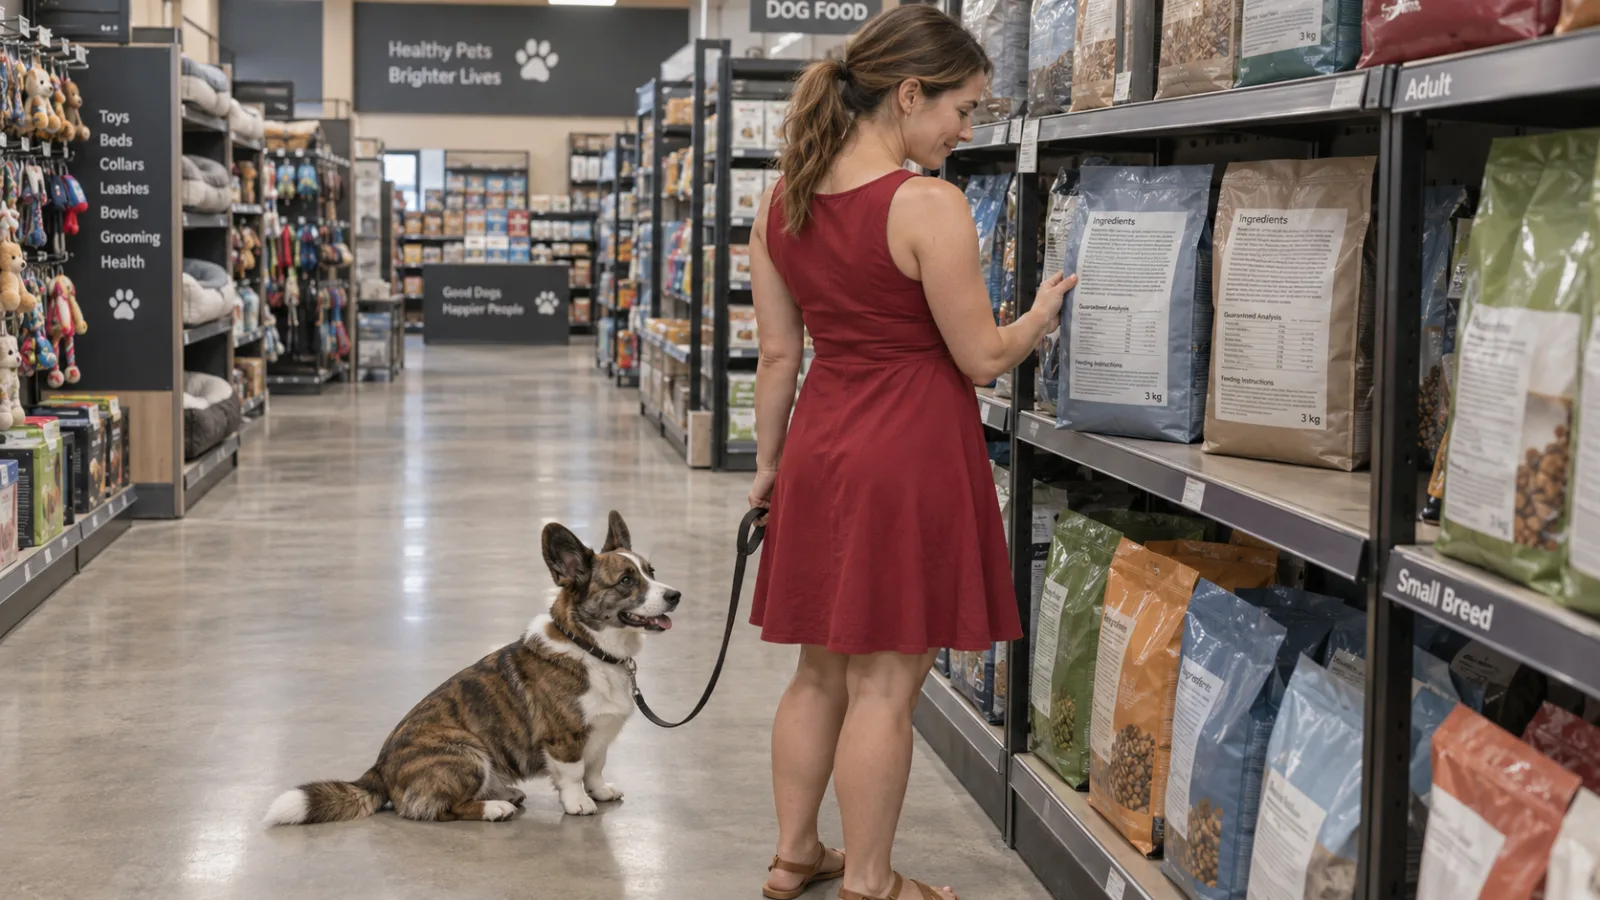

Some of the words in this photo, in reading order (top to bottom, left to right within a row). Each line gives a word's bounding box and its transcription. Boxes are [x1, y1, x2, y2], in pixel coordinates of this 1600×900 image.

[766, 0, 810, 19] DOG
[815, 2, 868, 20] FOOD
[1300, 31, 1305, 41] 3
[1306, 30, 1316, 41] kg
[388, 40, 453, 63] Healthy
[456, 41, 493, 60] Pets
[388, 66, 457, 88] Brighter
[460, 67, 502, 86] Lives
[1405, 73, 1452, 101] Adult
[99, 109, 130, 127] Toys
[100, 133, 133, 147] Beds
[100, 156, 145, 171] Collars
[100, 181, 149, 195] Leashes
[100, 205, 139, 219] Bowls
[1239, 213, 1289, 226] Ingredients
[1092, 217, 1136, 227] Ingredients
[100, 230, 161, 247] Grooming
[101, 254, 145, 269] Health
[442, 285, 473, 299] Good
[474, 285, 502, 301] Dogs
[442, 303, 486, 318] Happier
[487, 302, 525, 318] People
[1144, 392, 1151, 401] 3
[1152, 392, 1163, 403] kg
[1300, 413, 1307, 423] 3
[1308, 414, 1321, 426] kg
[1396, 567, 1441, 607] Small
[1441, 585, 1494, 632] Breed
